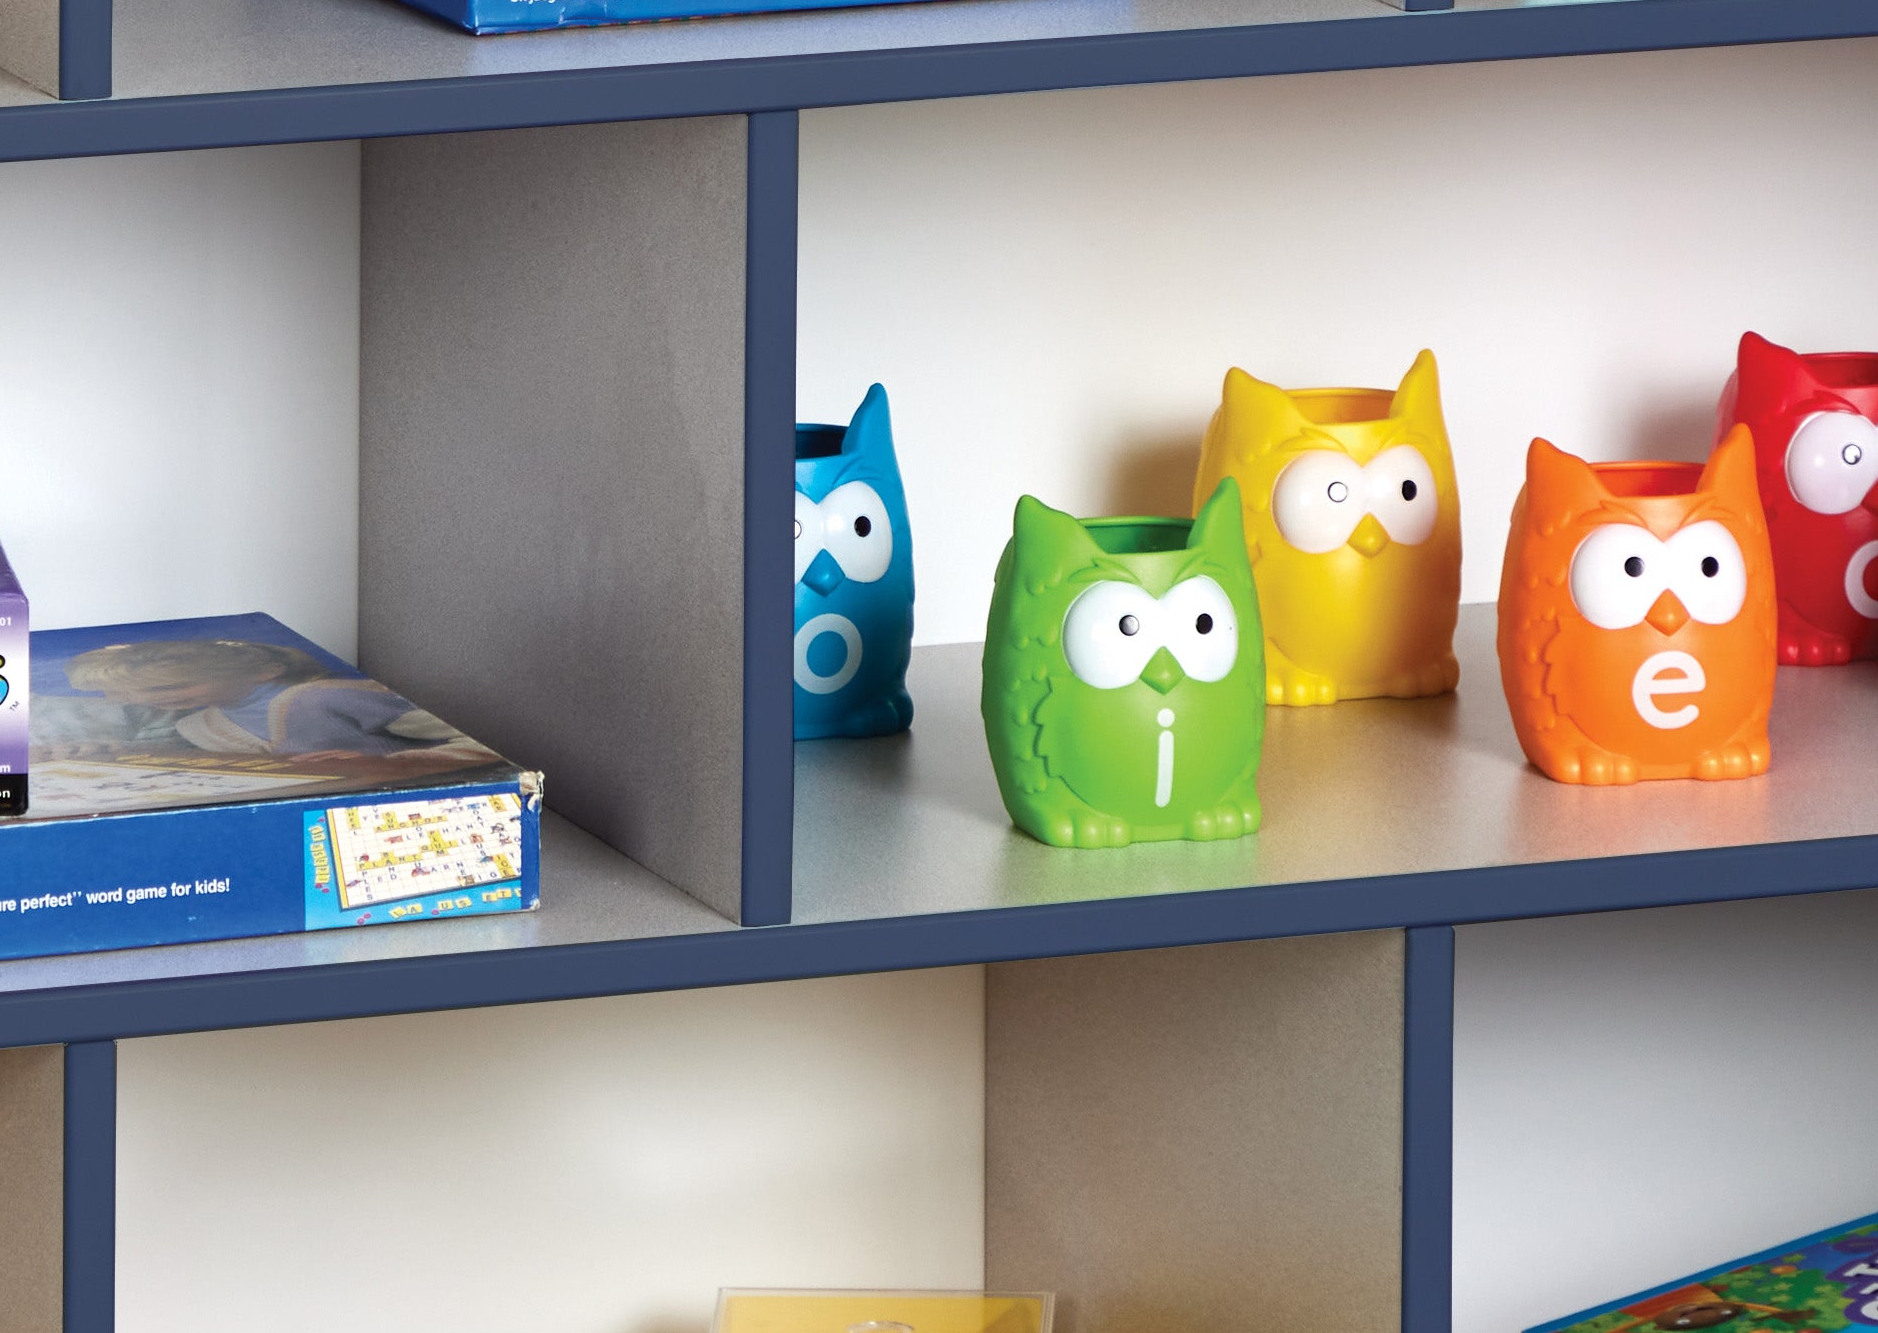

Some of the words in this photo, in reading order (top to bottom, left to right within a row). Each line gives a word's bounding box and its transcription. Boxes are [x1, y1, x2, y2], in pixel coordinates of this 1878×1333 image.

[1630, 650, 1706, 730] e
[1153, 709, 1176, 807] i
[19, 890, 82, 915] perfect"
[86, 887, 123, 906] word
[125, 884, 167, 905] game
[170, 881, 192, 897] for
[194, 877, 231, 896] kids!
